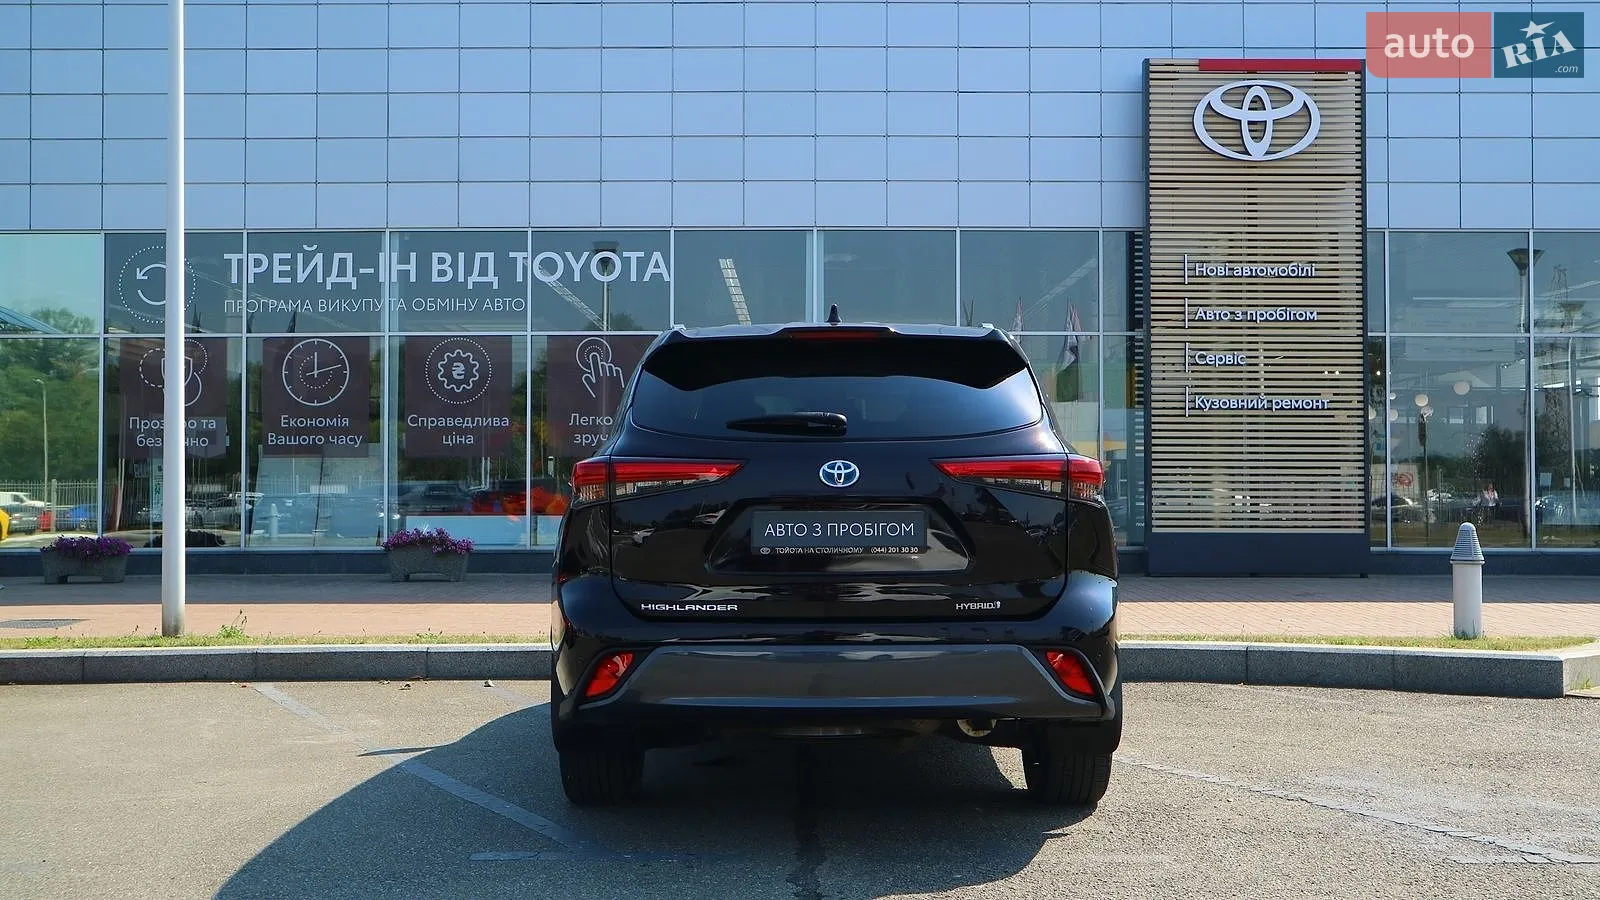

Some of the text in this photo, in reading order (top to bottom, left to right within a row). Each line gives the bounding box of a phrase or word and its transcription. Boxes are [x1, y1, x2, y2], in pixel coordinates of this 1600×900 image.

[223, 244, 671, 291] ТРЕЙД-ІН ВІД TOYOTA
[1194, 262, 1316, 277] Нові автомобілі
[223, 298, 526, 313] ПРОГРАМА ВИКУПУ ТА ОБМІНУ АВТО
[1194, 307, 1319, 324] Авто з пробігом
[1194, 351, 1247, 367] Сервіс
[1194, 395, 1330, 413] Кузовний ремонт
[200, 419, 216, 429] та
[280, 414, 349, 427] Економія
[407, 414, 510, 430] Справедлива
[568, 413, 614, 426] Легко
[267, 432, 363, 448] Вашого часу
[442, 433, 474, 447] ціна
[764, 523, 808, 537] АВТО
[827, 522, 915, 537] ПРОБІГОМ
[870, 546, 887, 554] (044)
[640, 603, 738, 611] HIGHLANDER
[955, 602, 994, 610] HYBRID
